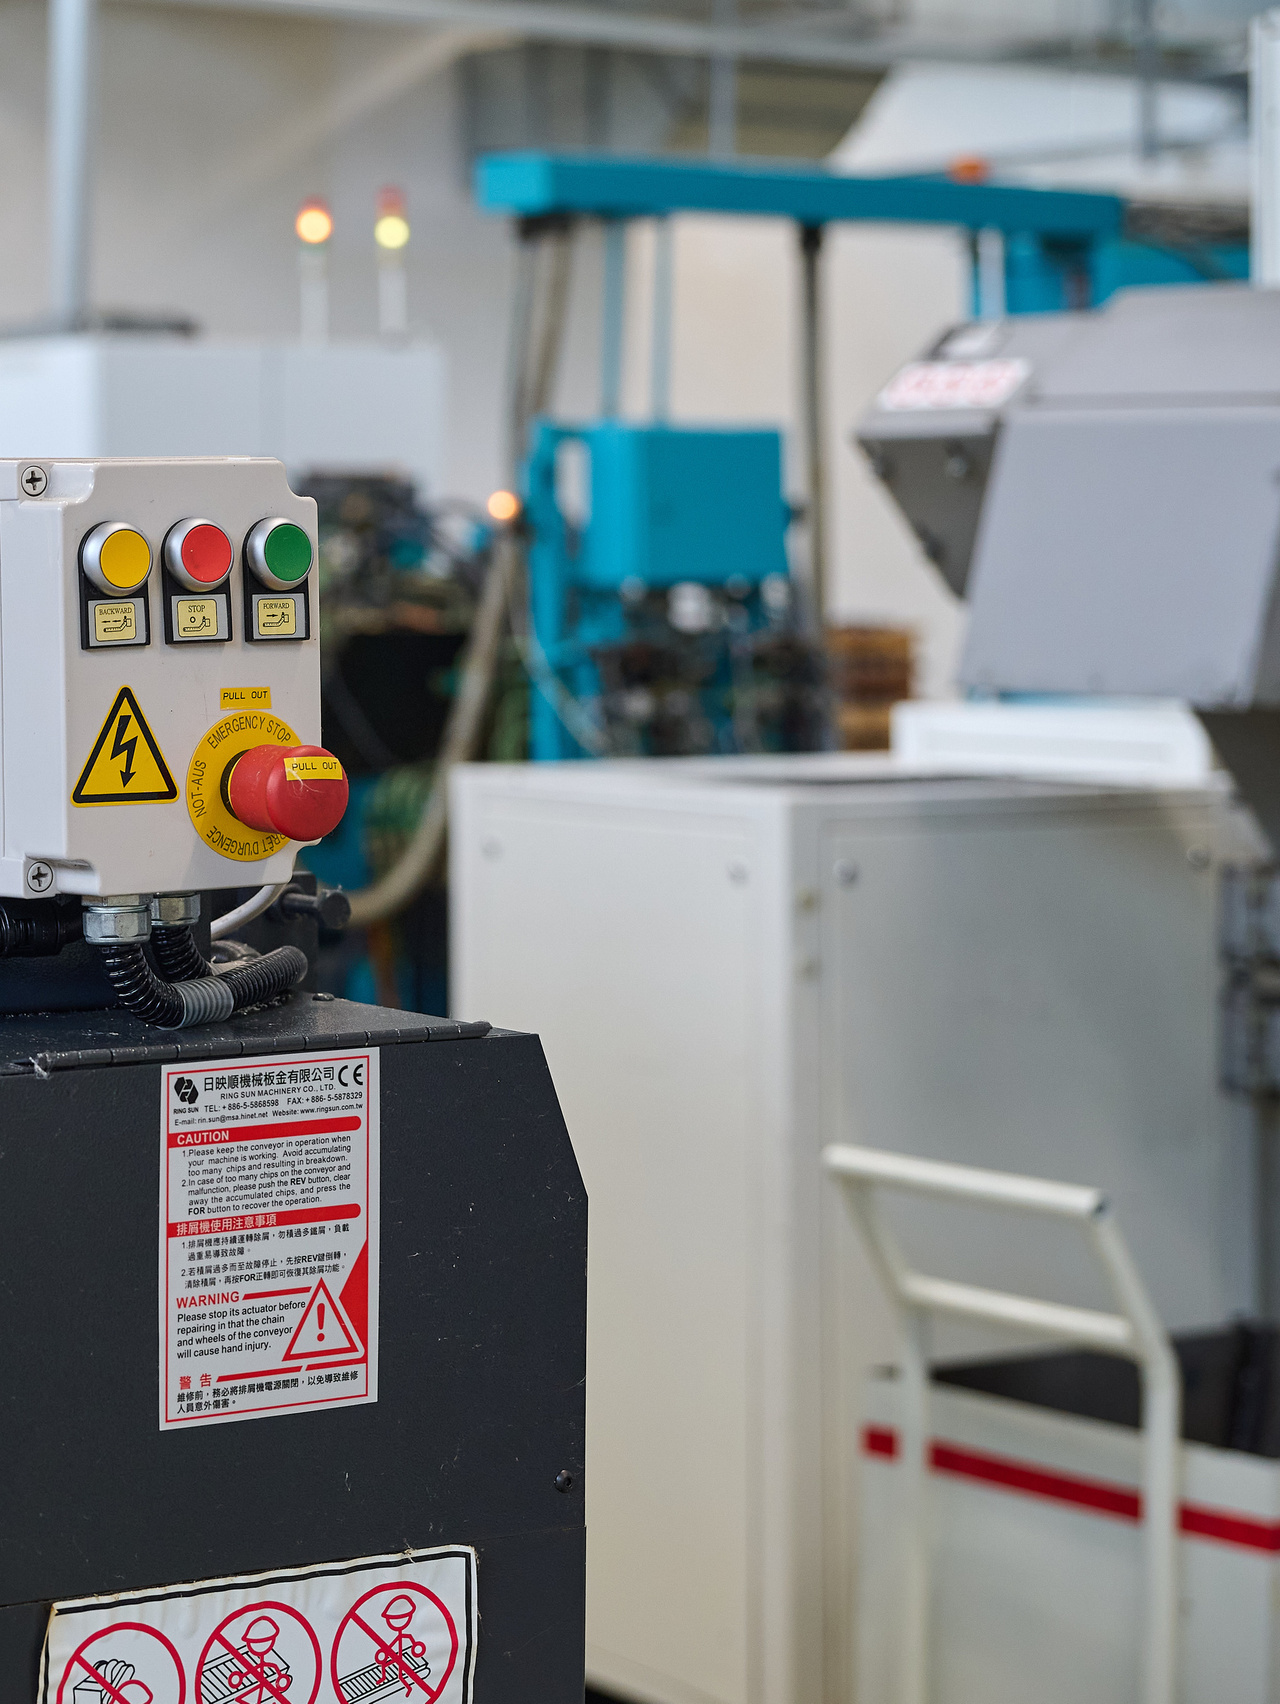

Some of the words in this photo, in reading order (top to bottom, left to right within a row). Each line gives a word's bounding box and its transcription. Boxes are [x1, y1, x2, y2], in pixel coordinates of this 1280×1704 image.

[99, 607, 132, 615] BACKWARD
[188, 605, 206, 613] STOP
[263, 602, 290, 610] FORWARD
[223, 692, 246, 700] PULL
[251, 691, 268, 699] OUT
[207, 715, 265, 749] EMERGENCY
[266, 720, 291, 742] STOP
[291, 761, 317, 771] PULL
[322, 762, 337, 770] OUT
[191, 760, 207, 818] NOT-AUS
[206, 826, 259, 856] D'URGENCE
[262, 833, 286, 852] RÊT
[220, 1091, 239, 1100] RING
[240, 1090, 256, 1098] SUN
[257, 1086, 302, 1097] MACHINERY
[187, 1106, 199, 1114] SUN
[177, 1130, 229, 1145] CAUTION
[216, 1146, 235, 1154] keep
[236, 1144, 249, 1152] the
[250, 1141, 285, 1151] conveyor
[286, 1139, 293, 1147] in
[294, 1136, 330, 1148] operation
[330, 1135, 351, 1143] when
[188, 1159, 204, 1169] your
[208, 1155, 239, 1164] machine
[282, 1148, 303, 1157] Avoid
[304, 1144, 351, 1156] accumulating
[188, 1169, 200, 1177] too
[201, 1167, 222, 1176] many
[225, 1164, 246, 1173] chips
[247, 1161, 262, 1171] and
[263, 1159, 296, 1169] resulting
[196, 1177, 215, 1186] case
[215, 1175, 224, 1184] of
[224, 1175, 237, 1183] too
[238, 1173, 258, 1182] many
[259, 1170, 279, 1180] chips
[290, 1168, 302, 1176] the
[303, 1165, 336, 1175] conveyor
[337, 1162, 351, 1172] and
[232, 1183, 257, 1193] please
[258, 1180, 275, 1191] push
[276, 1179, 288, 1187] the
[289, 1176, 307, 1186] REV
[333, 1173, 351, 1182] clear
[188, 1198, 209, 1206] away
[210, 1196, 223, 1204] the
[225, 1189, 273, 1202] accumulated
[299, 1185, 314, 1195] and
[316, 1184, 337, 1194] press
[338, 1182, 351, 1190] the
[187, 1206, 205, 1216] FOR
[207, 1205, 231, 1214] button
[241, 1201, 270, 1210] recover
[271, 1199, 283, 1207] the
[176, 1290, 239, 1309] WARNING
[177, 1312, 207, 1323] Please
[208, 1310, 228, 1319] stop
[229, 1307, 240, 1317] its
[241, 1304, 277, 1315] actuator
[278, 1300, 306, 1311] before
[176, 1322, 216, 1336] repairing
[217, 1321, 226, 1330] in
[227, 1318, 244, 1329] that
[245, 1317, 260, 1327] the
[261, 1314, 285, 1325] chain
[176, 1336, 193, 1347] and
[194, 1333, 226, 1345] wheels
[227, 1331, 237, 1341] of
[237, 1330, 252, 1340] the
[252, 1326, 293, 1338] conveyor
[176, 1348, 192, 1359] will
[193, 1347, 220, 1357] cause
[221, 1342, 243, 1354] hand
